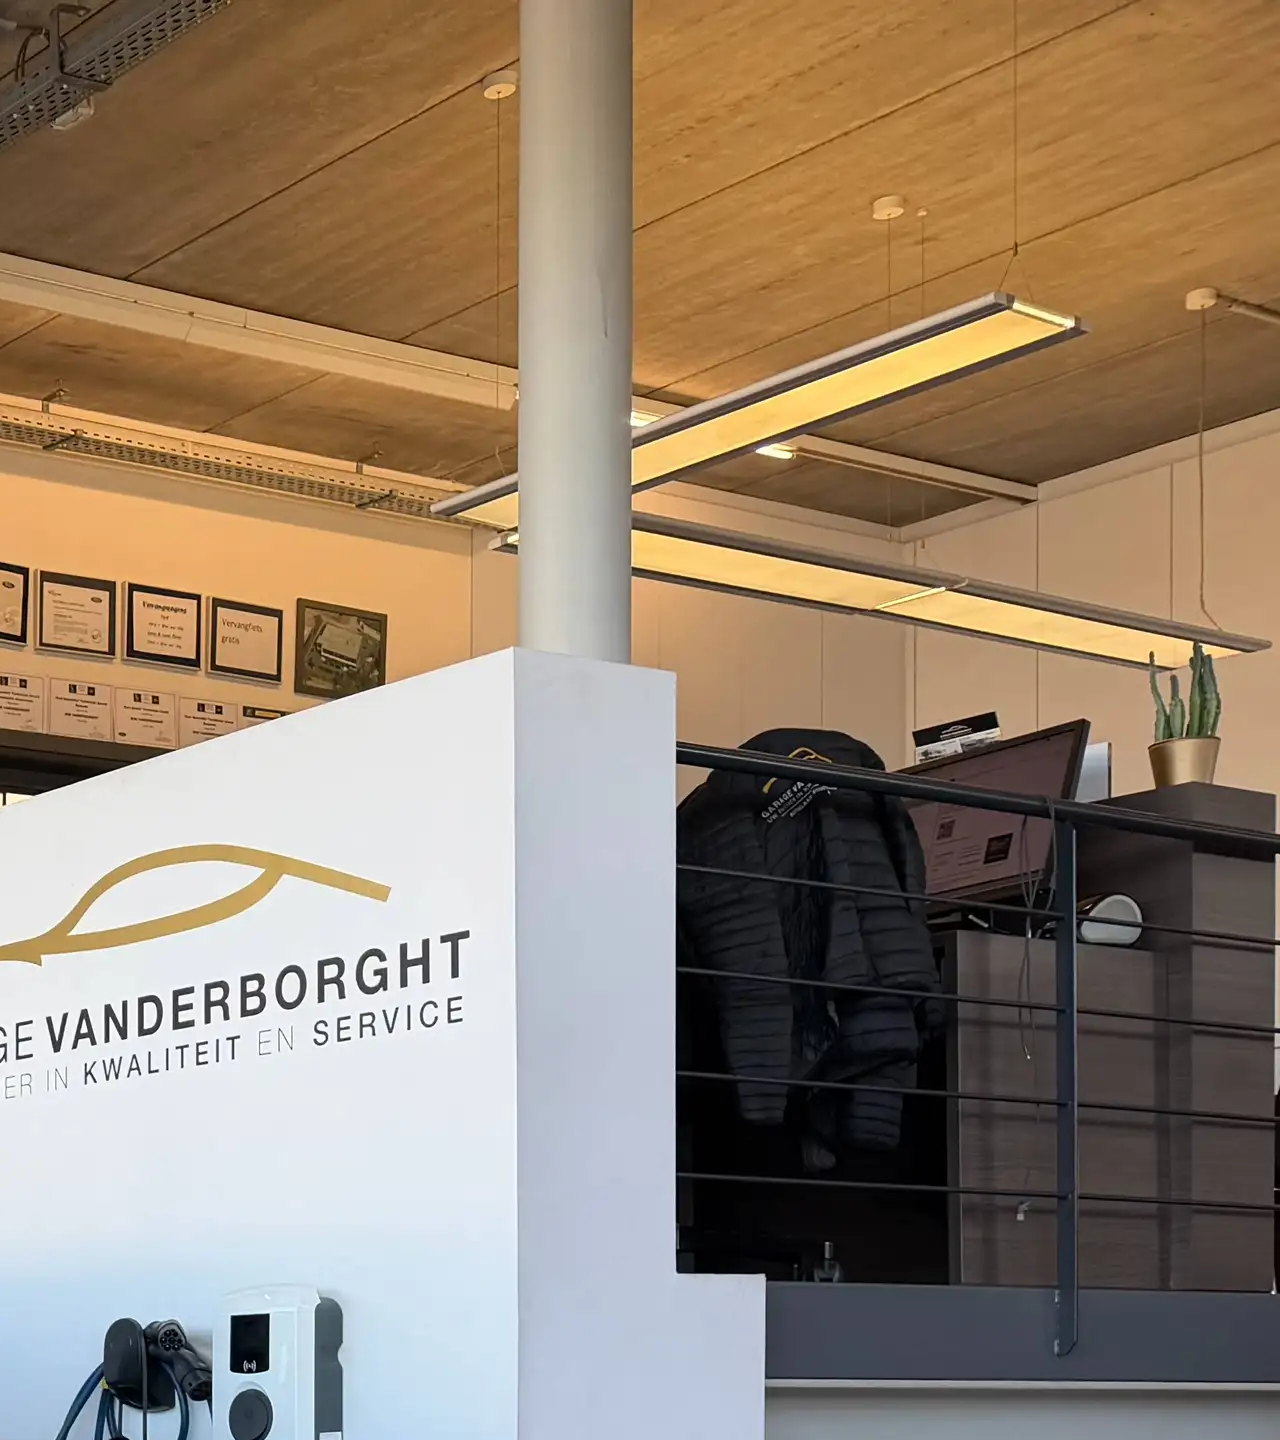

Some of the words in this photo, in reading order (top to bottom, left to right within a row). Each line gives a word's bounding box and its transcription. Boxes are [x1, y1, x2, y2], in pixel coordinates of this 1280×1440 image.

[761, 787, 792, 819] GARAGE
[45, 929, 471, 1053] VANDERBORGHT
[46, 1066, 68, 1092] IN
[83, 1035, 241, 1085] KWALITEIT
[258, 1025, 294, 1056] EN
[312, 995, 464, 1046] SERVICE
